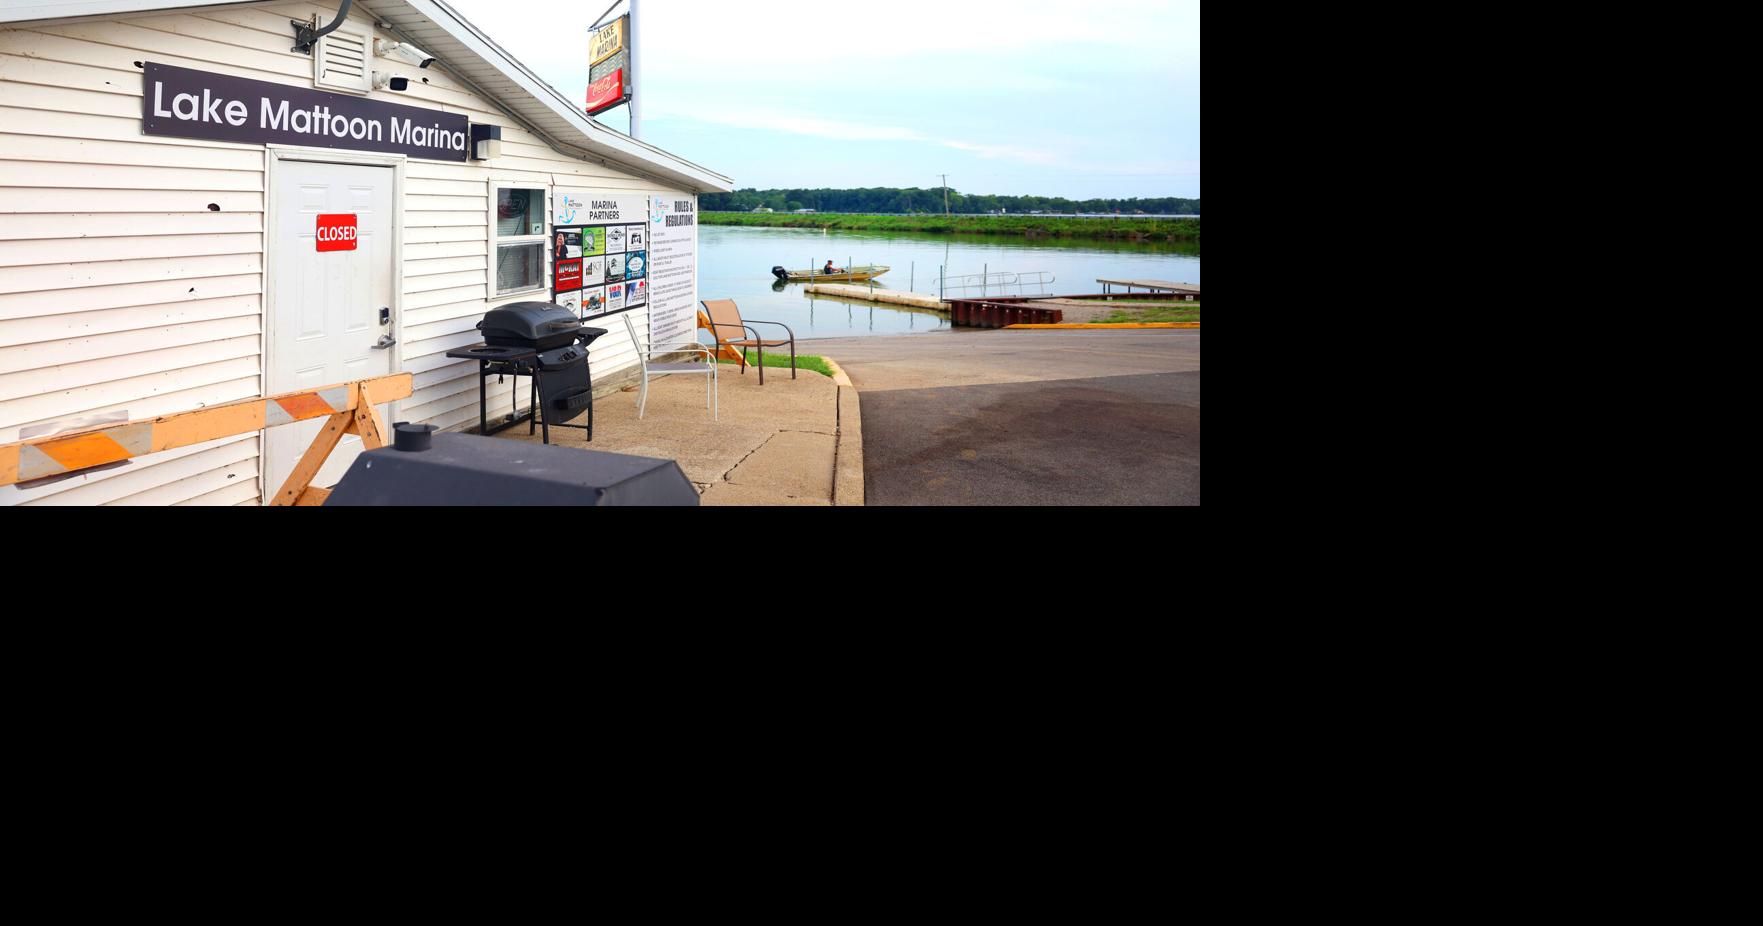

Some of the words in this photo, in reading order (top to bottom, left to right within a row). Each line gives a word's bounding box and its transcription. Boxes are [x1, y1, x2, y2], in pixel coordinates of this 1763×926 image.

[599, 25, 614, 43] LAKE
[153, 81, 248, 127] Lake
[260, 97, 382, 141] Mattoon
[390, 116, 465, 151] Marina
[591, 200, 617, 210] MARINA
[674, 200, 689, 213] RULES
[689, 201, 694, 213] &
[589, 210, 620, 220] PARTNERS
[665, 214, 694, 227] REGULATIONS
[317, 225, 357, 242] CLOSED
